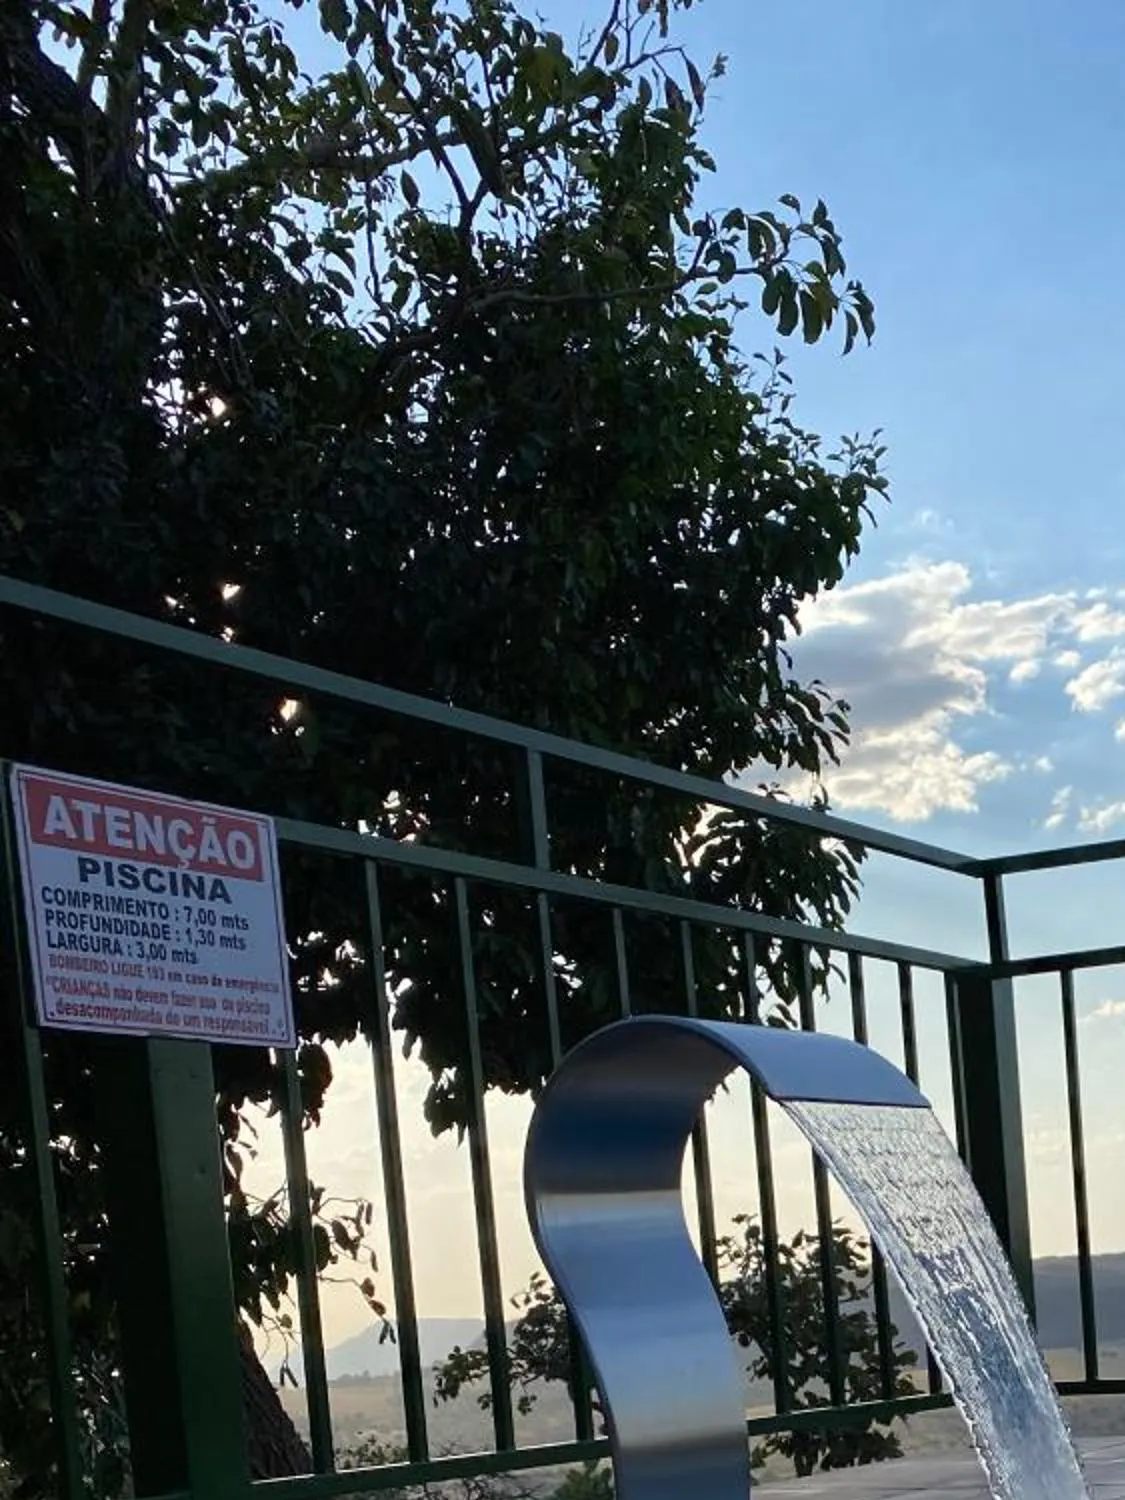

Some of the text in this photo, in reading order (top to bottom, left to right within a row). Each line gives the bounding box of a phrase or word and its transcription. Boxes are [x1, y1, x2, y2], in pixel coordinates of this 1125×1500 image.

[44, 795, 255, 869] ATENÇÃO
[78, 856, 232, 904] PISCINA
[42, 886, 169, 920] COMPRIMENTO
[183, 906, 217, 926] 7,00
[221, 913, 249, 931] mts
[45, 909, 171, 941] PROFUNDIDADE
[185, 927, 215, 948] 1,30
[219, 934, 247, 950] mts
[46, 930, 123, 956] LARGURA
[137, 941, 167, 962] 3,00
[171, 947, 198, 964] mts
